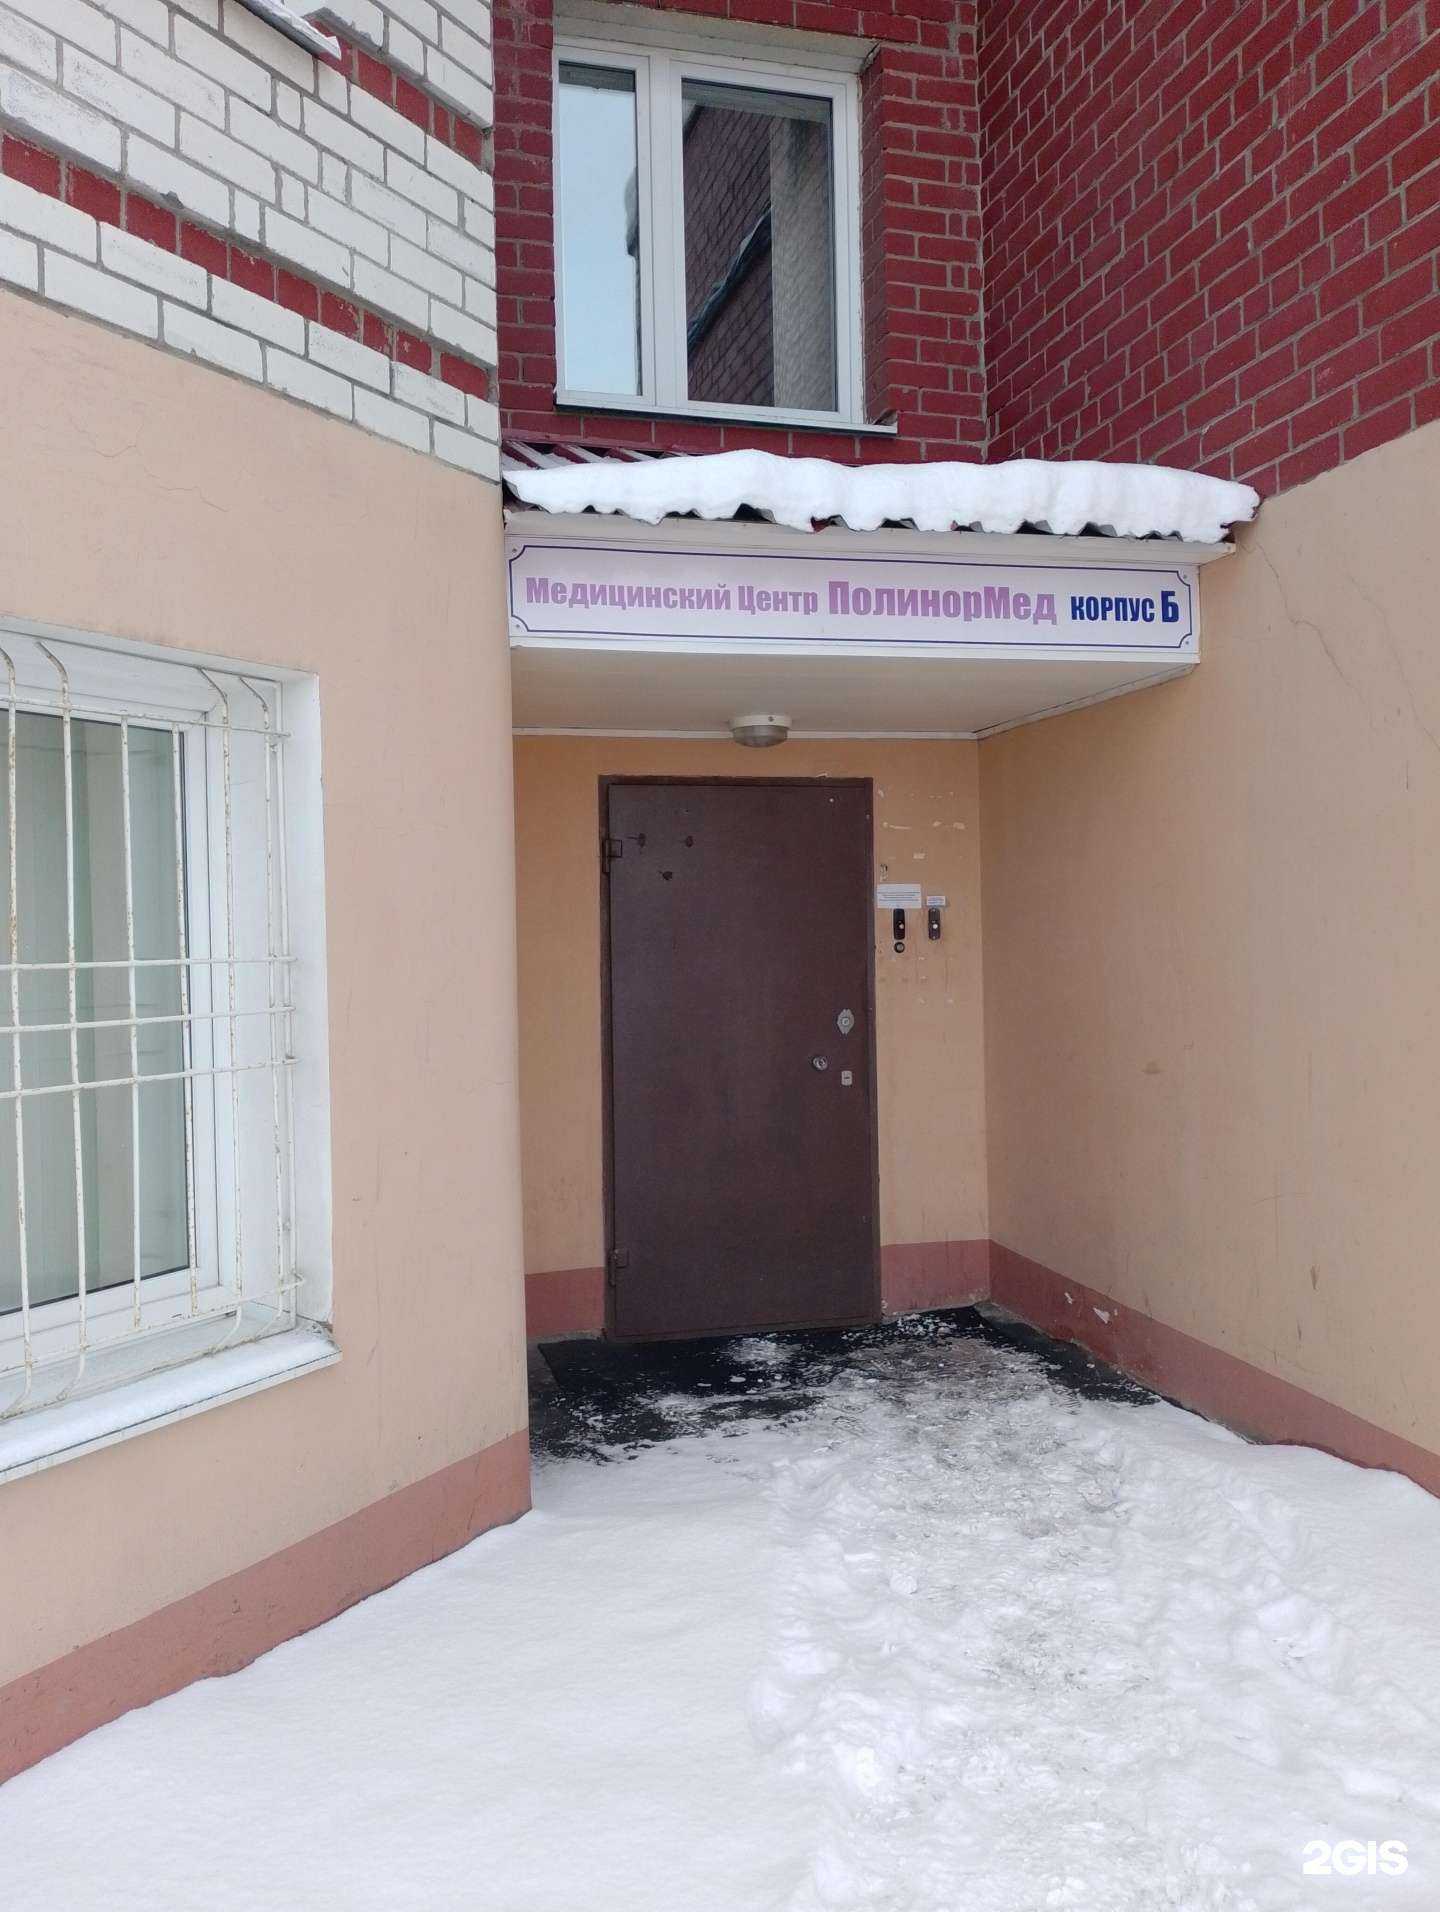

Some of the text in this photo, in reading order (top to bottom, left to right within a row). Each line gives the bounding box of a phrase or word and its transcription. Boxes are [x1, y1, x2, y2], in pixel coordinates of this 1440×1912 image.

[525, 577, 1179, 625] Медицинский Центр ПолинорМед КОРПУС Б
